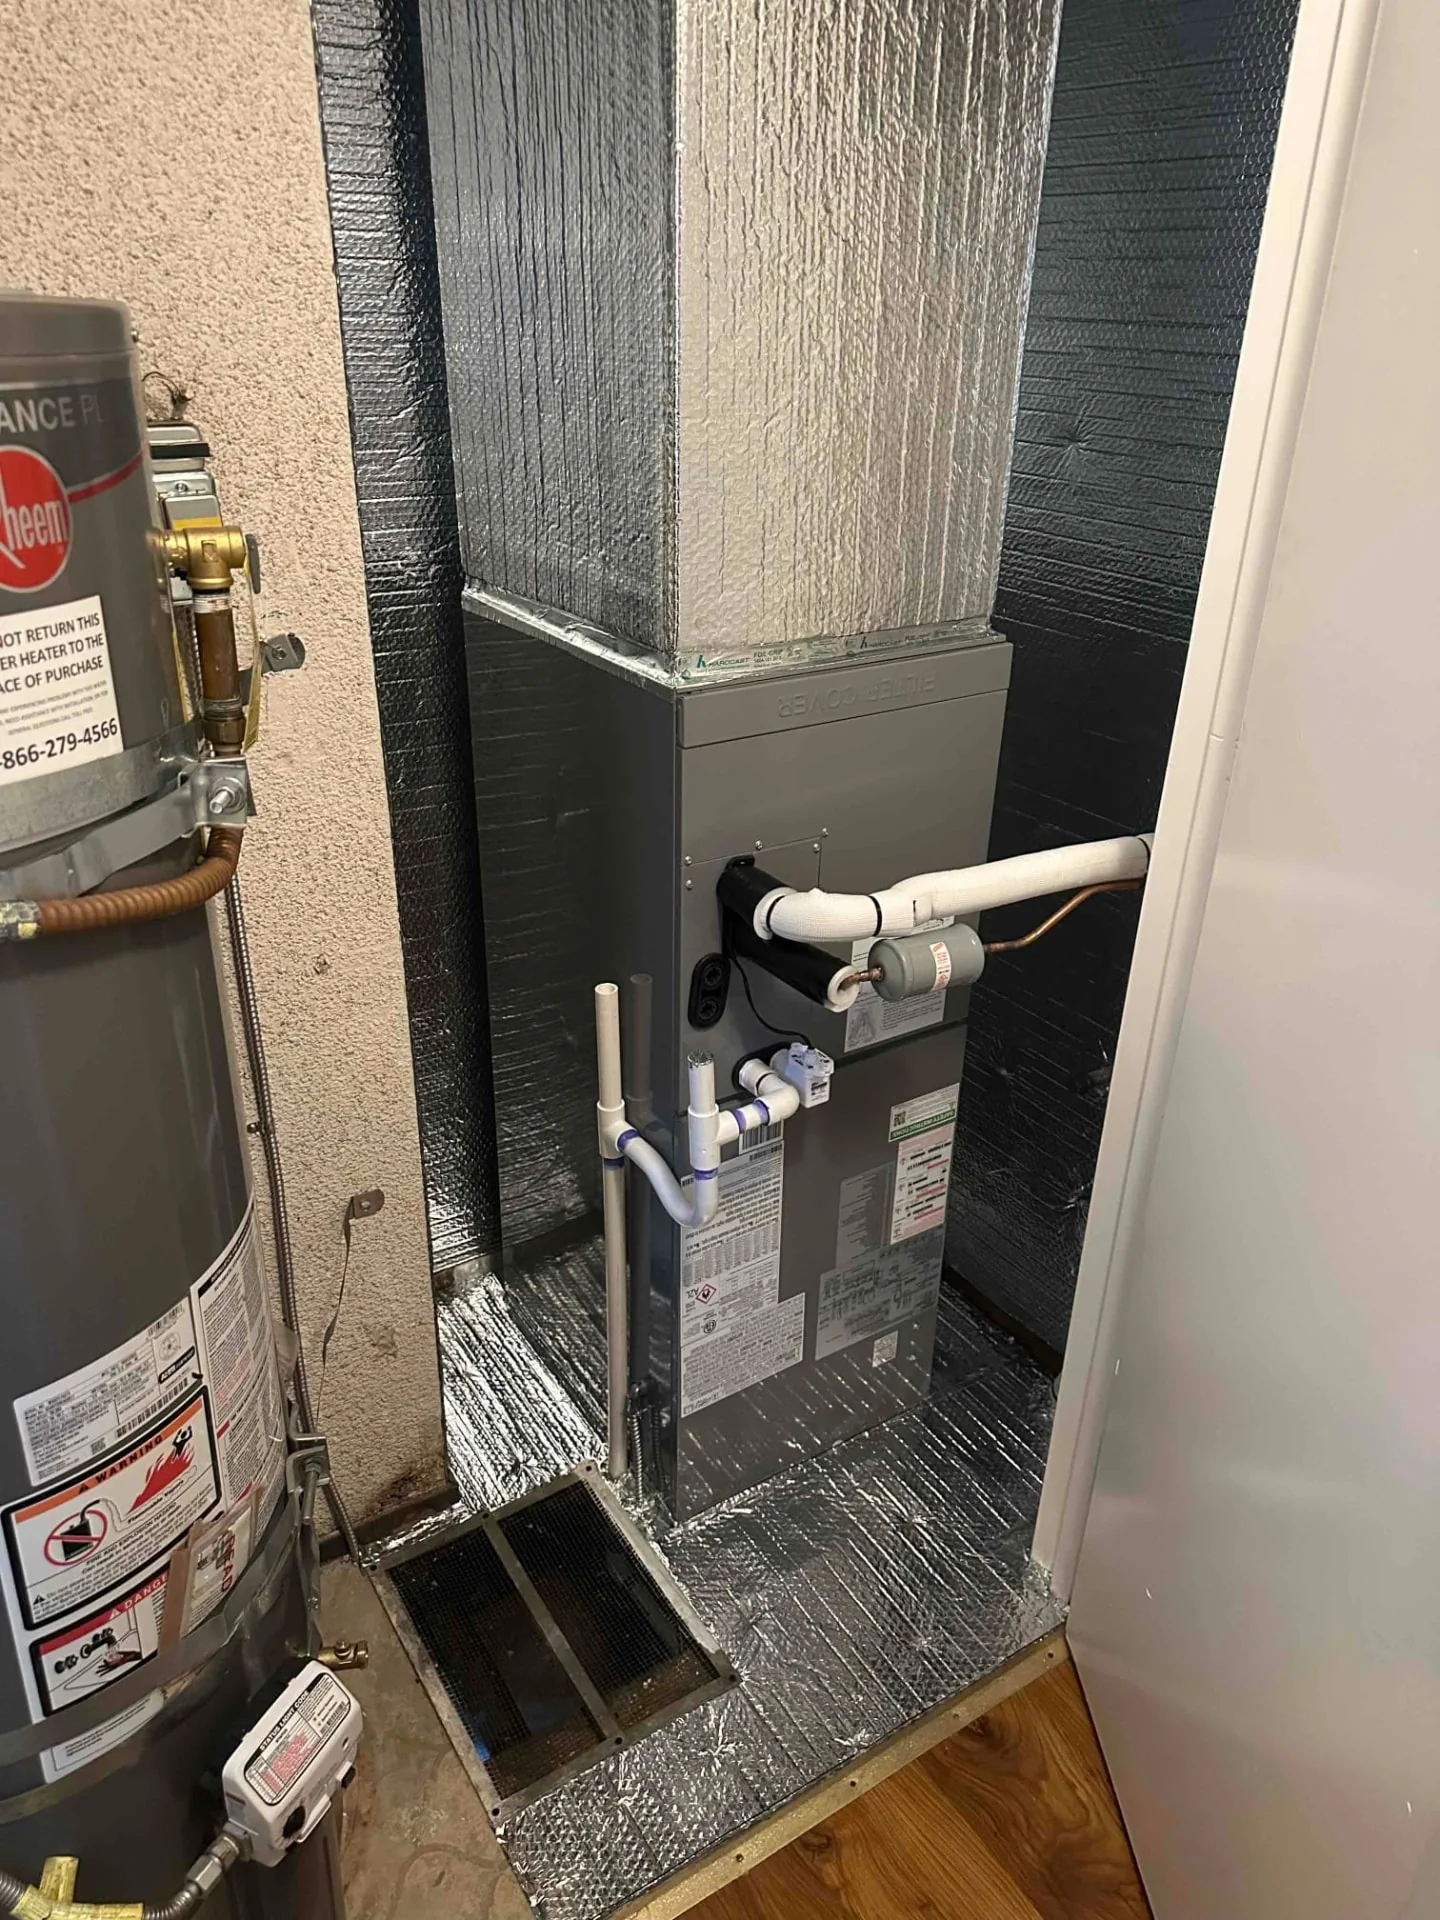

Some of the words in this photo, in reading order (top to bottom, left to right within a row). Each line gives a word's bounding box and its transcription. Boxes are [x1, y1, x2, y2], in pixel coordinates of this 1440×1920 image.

[26, 619, 75, 643] RETURN
[76, 612, 100, 632] THIS
[19, 643, 68, 667] HEATER
[68, 639, 84, 655] TO
[85, 633, 104, 650] THE
[25, 671, 43, 689] OF
[45, 655, 104, 684] PURCHASE
[866, 669, 936, 704] FILTER
[777, 685, 857, 719] COVER
[95, 1435, 164, 1485] WARNING
[222, 1530, 235, 1592] READ
[260, 1725, 281, 1751] STATUS
[280, 1706, 297, 1727] LIGHT
[295, 1690, 310, 1708] CODE
